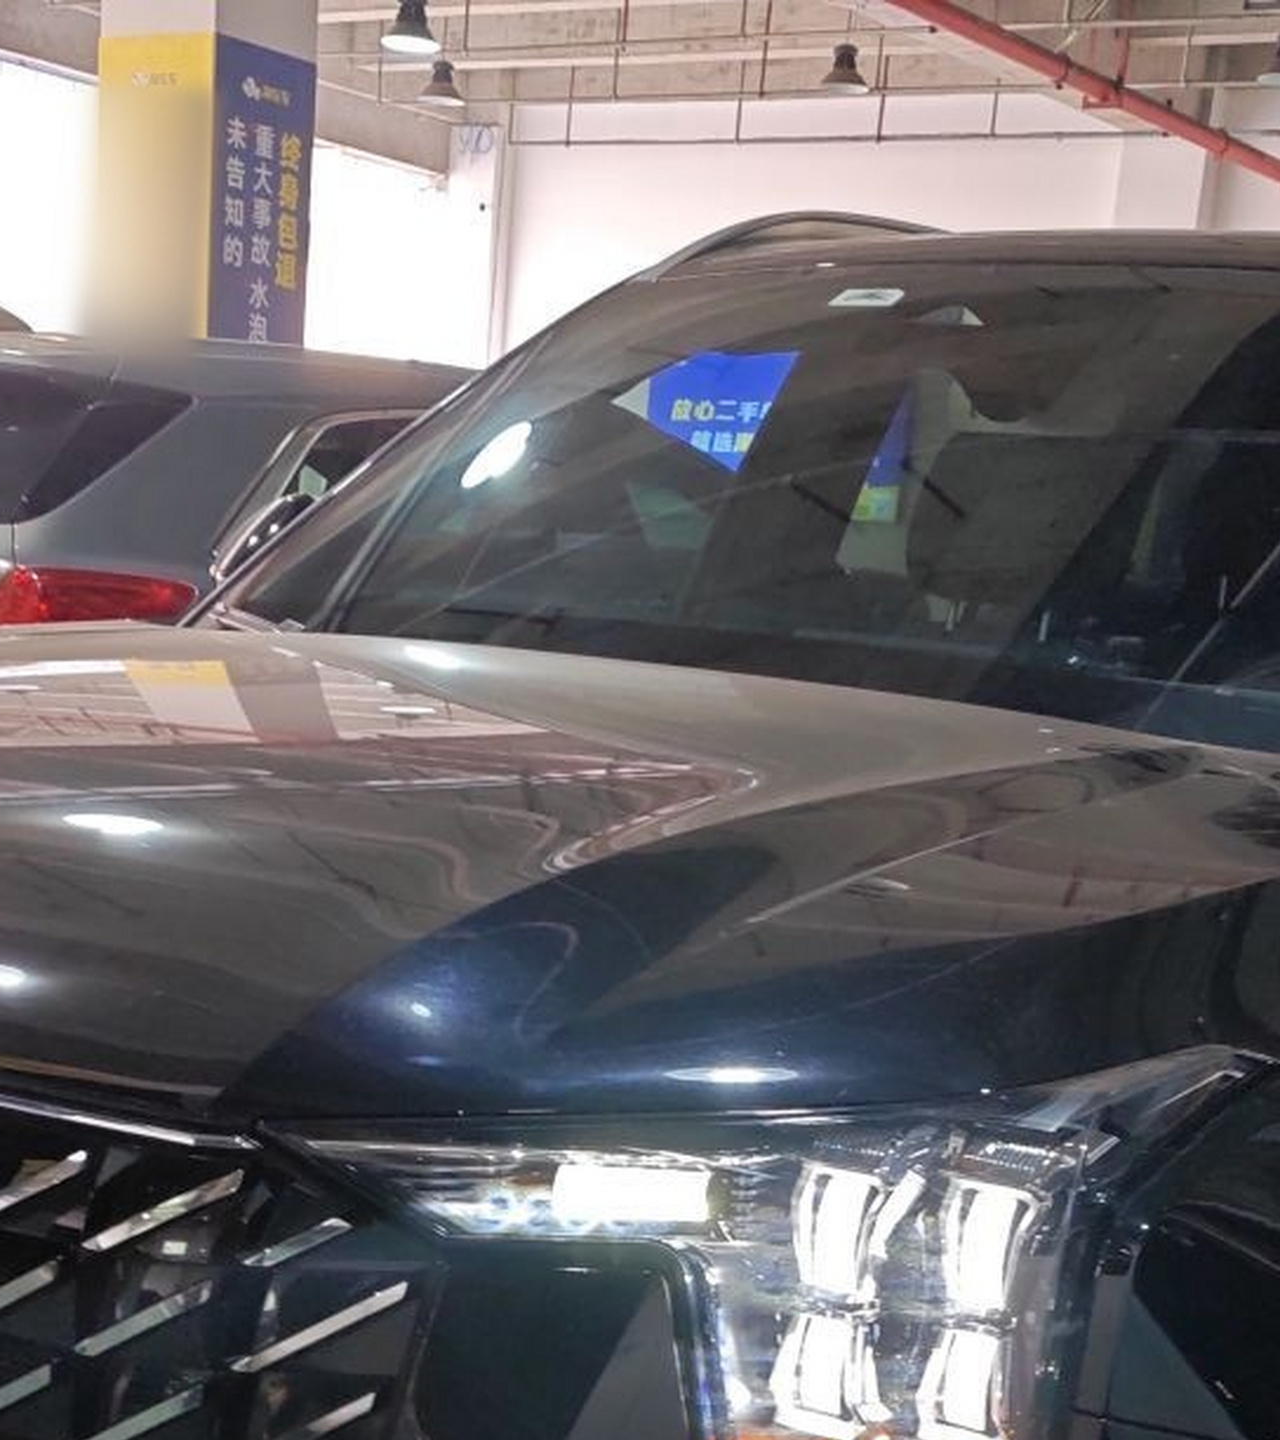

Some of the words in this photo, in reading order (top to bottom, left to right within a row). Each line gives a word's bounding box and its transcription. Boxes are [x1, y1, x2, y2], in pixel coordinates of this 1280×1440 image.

[223, 116, 246, 267] 未告知的
[251, 124, 276, 267] 重大事故
